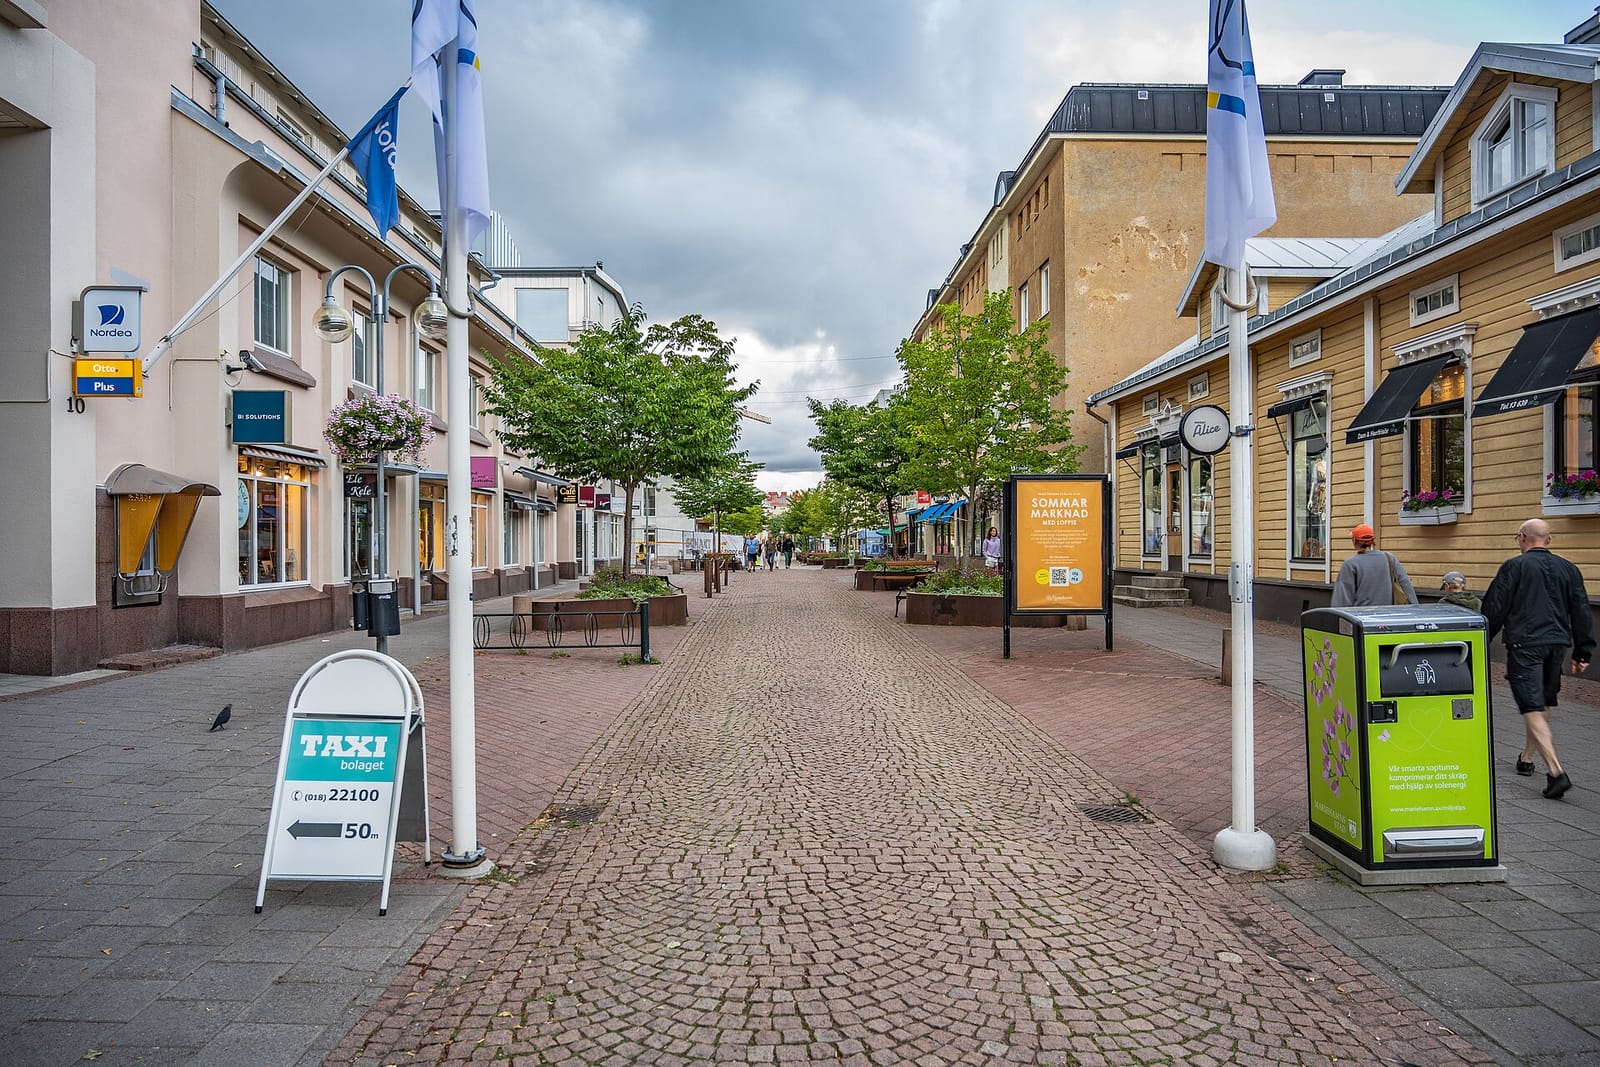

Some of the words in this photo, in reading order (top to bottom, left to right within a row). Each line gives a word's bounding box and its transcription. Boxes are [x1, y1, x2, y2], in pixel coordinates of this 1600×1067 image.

[90, 328, 133, 338] Nordea
[66, 396, 86, 414] 10
[1192, 425, 1222, 438] Alice
[345, 473, 363, 484] Ele
[350, 485, 372, 498] Kele
[559, 486, 577, 495] Café
[1031, 498, 1088, 508] SOMMAR
[1031, 509, 1089, 519] MARKNAD
[300, 734, 388, 758] TAXI
[340, 759, 385, 773] bolaget
[1388, 764, 1400, 772] Vår
[1401, 764, 1425, 772] smarta
[1426, 764, 1460, 773] soptunna
[1389, 774, 1434, 783] komprimerar
[1389, 783, 1405, 791] med
[1406, 782, 1424, 791] hjälp
[1434, 781, 1467, 790] solenergi
[304, 792, 327, 803] (018)
[328, 788, 380, 803] 22100
